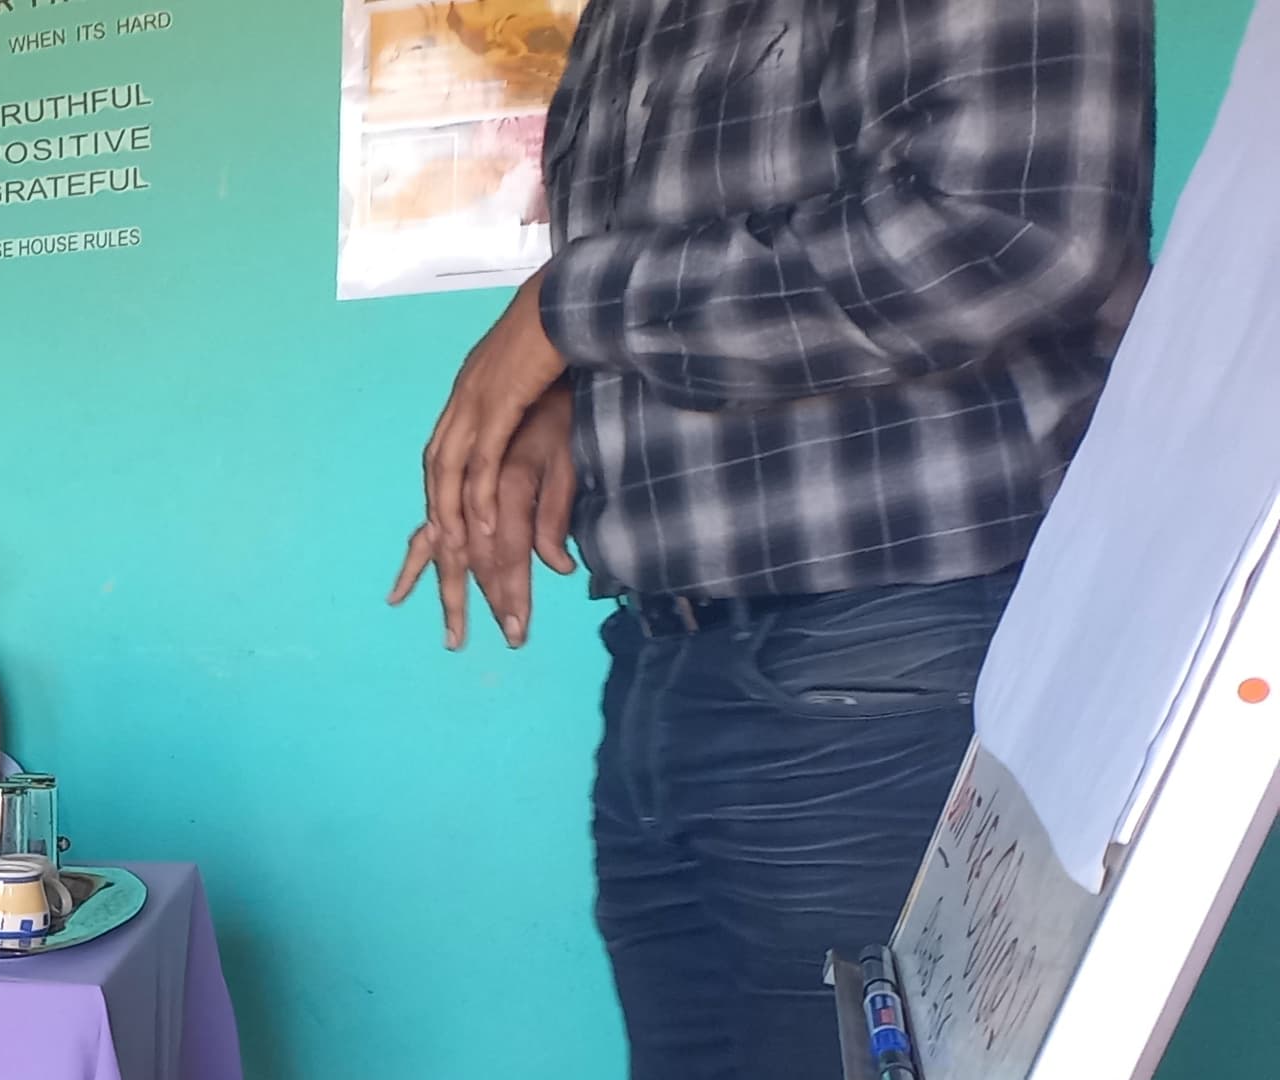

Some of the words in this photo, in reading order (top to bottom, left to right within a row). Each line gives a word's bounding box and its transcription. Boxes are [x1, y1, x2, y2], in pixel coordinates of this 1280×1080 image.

[8, 29, 65, 53] WHEN
[76, 22, 106, 42] ITS
[117, 11, 172, 34] HARD
[18, 234, 79, 257] HOUSE
[83, 228, 141, 249] RULES
